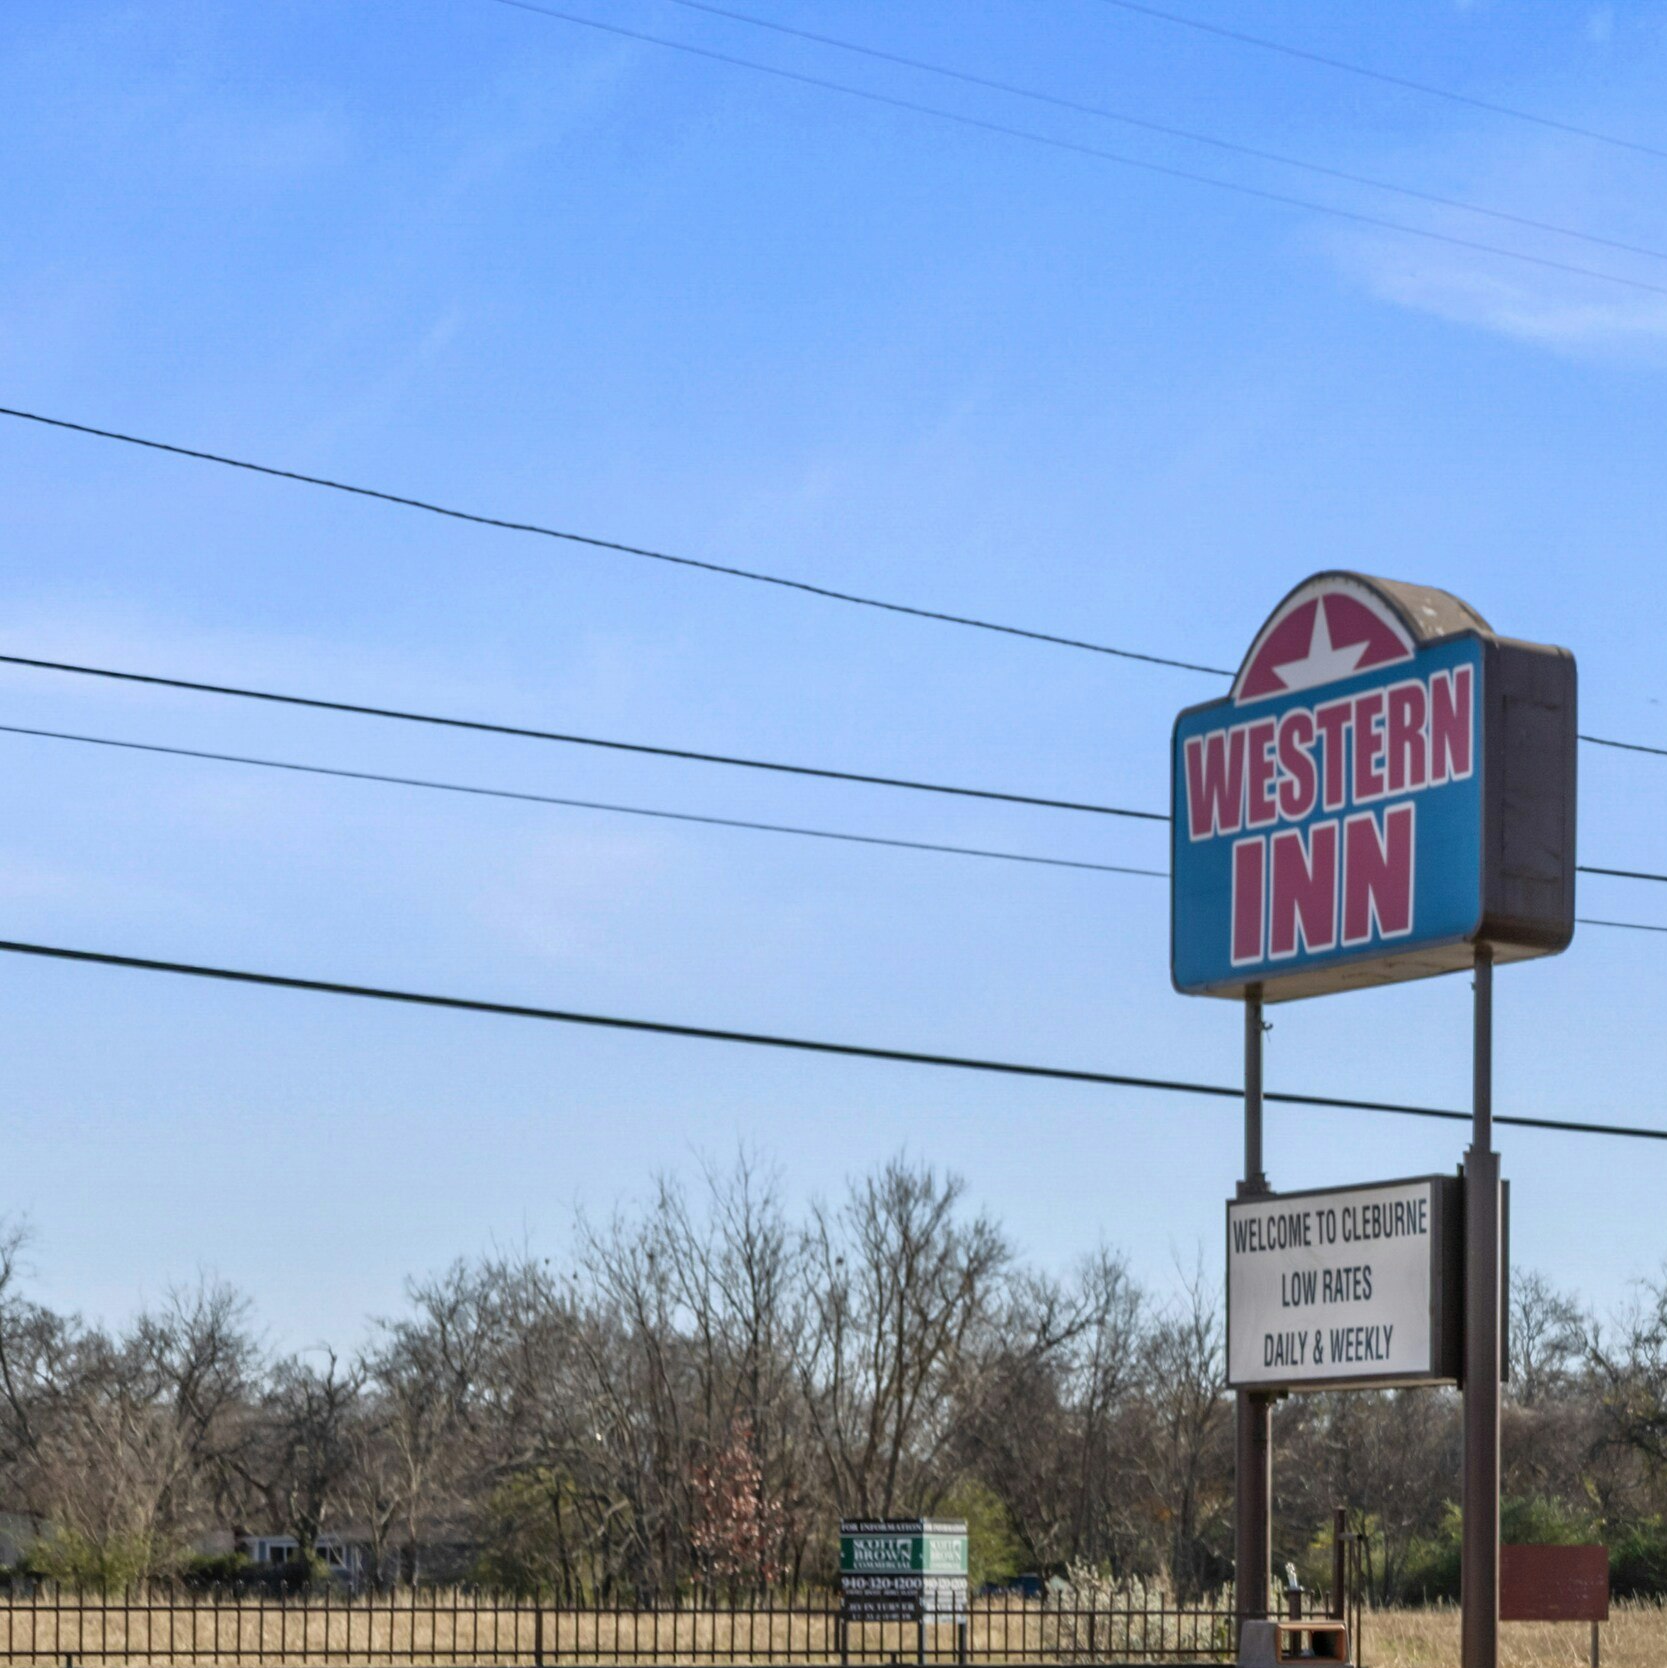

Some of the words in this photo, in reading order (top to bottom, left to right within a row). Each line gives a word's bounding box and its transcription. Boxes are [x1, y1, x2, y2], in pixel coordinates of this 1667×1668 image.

[1184, 663, 1474, 843] WESTERN
[1230, 801, 1416, 967] INN
[1233, 1212, 1311, 1253] WELCOME
[1316, 1209, 1336, 1245] TO
[1342, 1198, 1428, 1243] CLEBURNE
[1281, 1270, 1317, 1308] LOW
[1323, 1265, 1373, 1304] RATES
[1264, 1330, 1308, 1368] DAILY
[1313, 1329, 1324, 1365] &
[1330, 1324, 1394, 1364] WEEKLY
[841, 1523, 858, 1532] FOR
[860, 1523, 922, 1532] INFORMATION
[853, 1539, 896, 1550] SCOTT
[853, 1550, 912, 1561] BROWN
